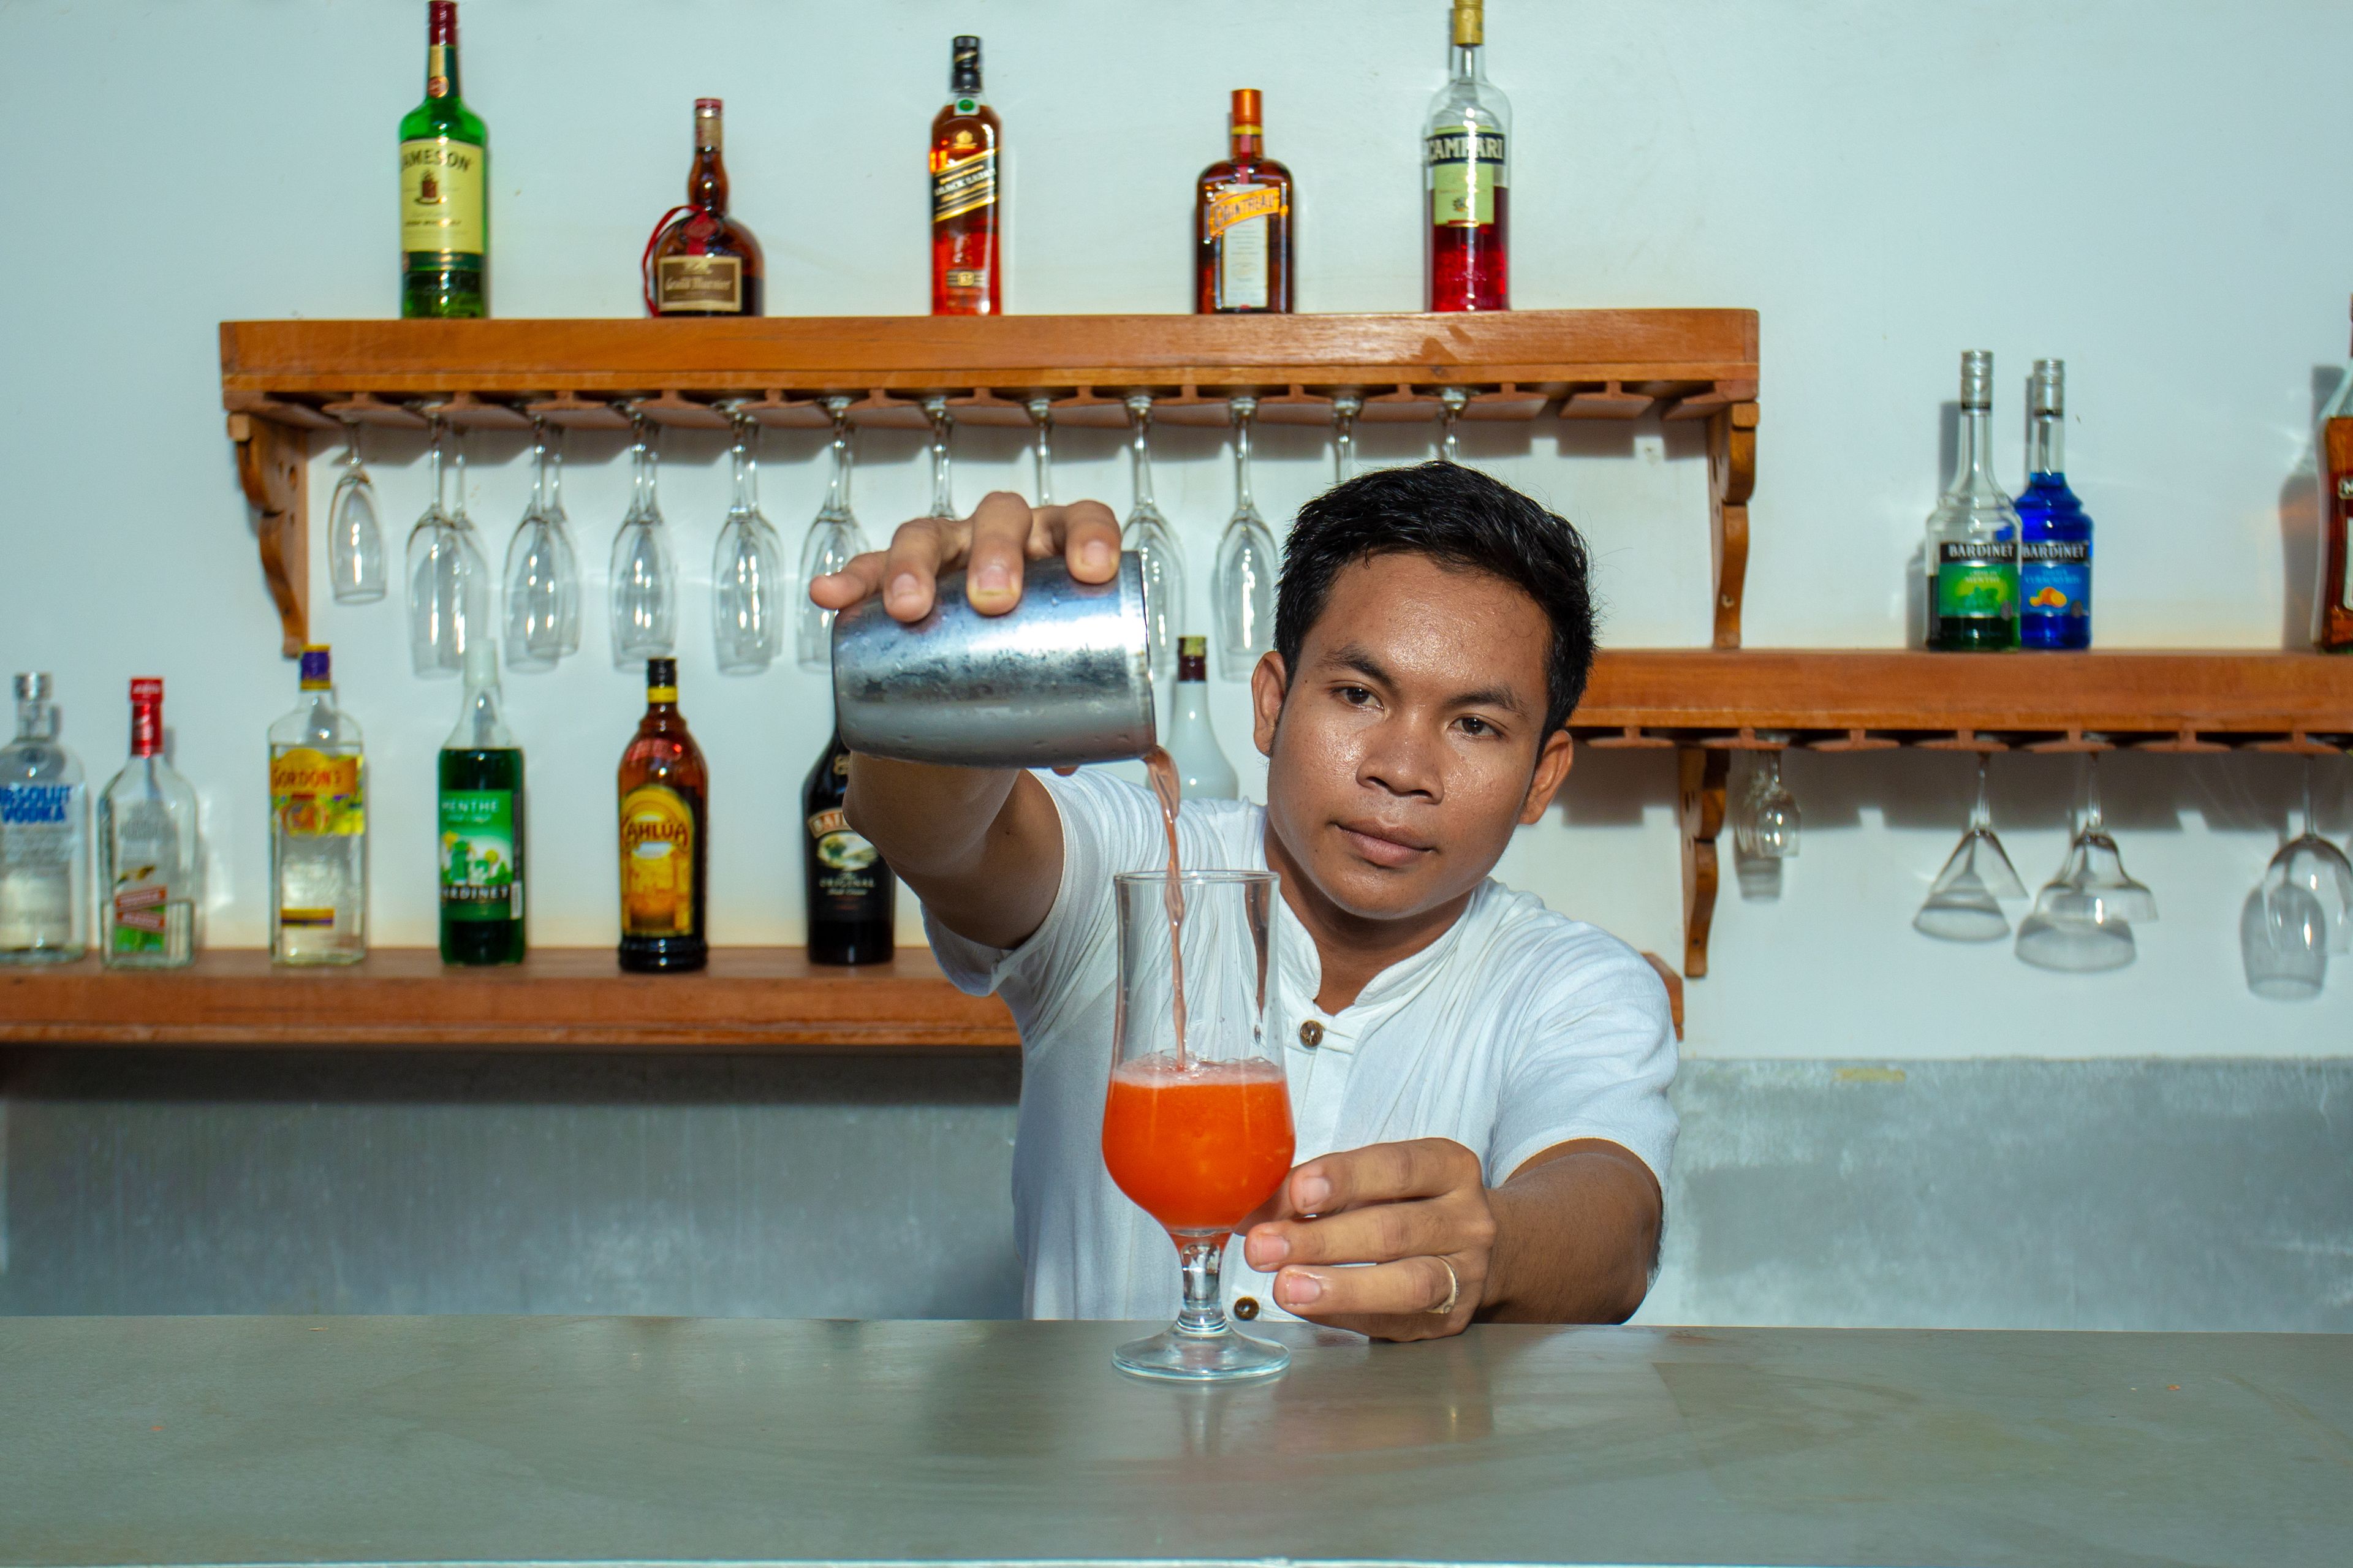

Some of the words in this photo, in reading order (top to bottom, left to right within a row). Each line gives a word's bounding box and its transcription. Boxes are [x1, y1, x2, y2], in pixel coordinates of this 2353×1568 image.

[1428, 136, 1504, 161] CAMPARI
[1949, 543, 2014, 558] BARDINET
[2022, 543, 2085, 559] BARDINET
